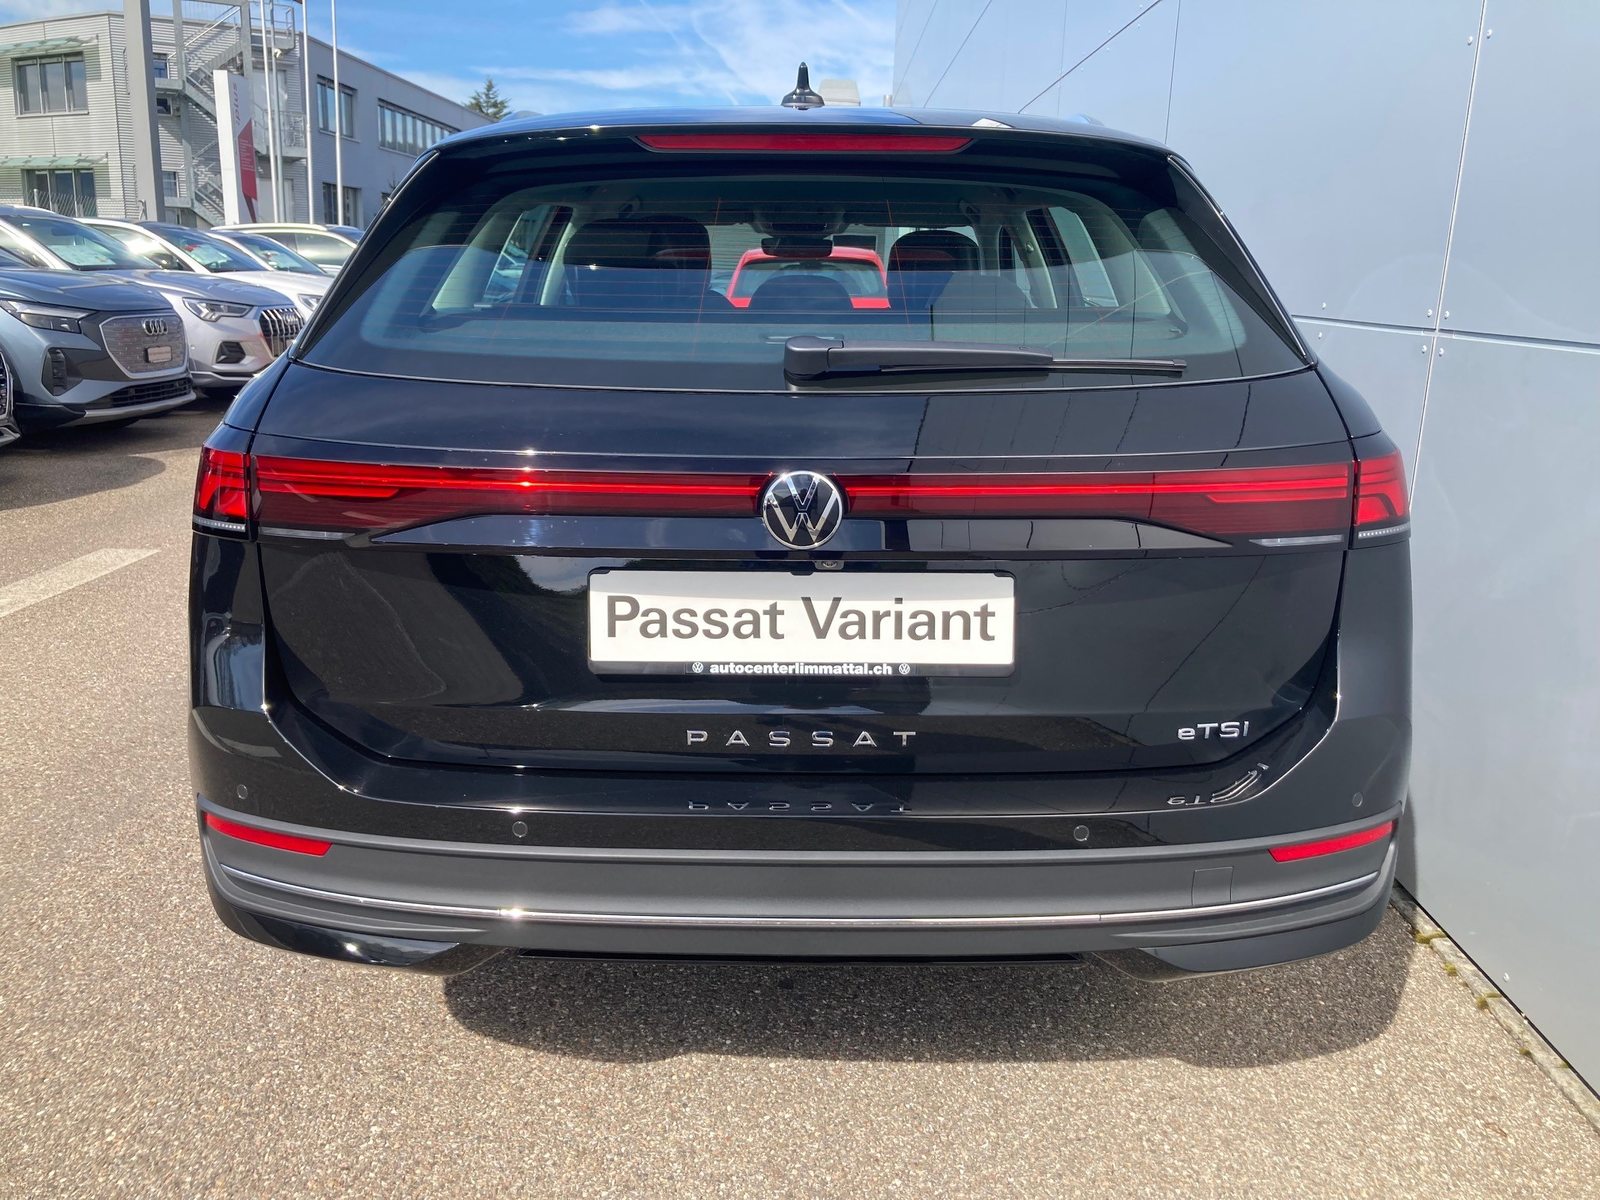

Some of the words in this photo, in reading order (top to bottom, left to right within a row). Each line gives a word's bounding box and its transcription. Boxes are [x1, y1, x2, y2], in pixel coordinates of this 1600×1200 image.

[606, 595, 785, 640] Passat
[801, 596, 996, 641] Variant
[710, 662, 892, 675] autocenterlimmattal.ch
[686, 730, 916, 747] PASSAT
[1177, 721, 1250, 740] eTSI
